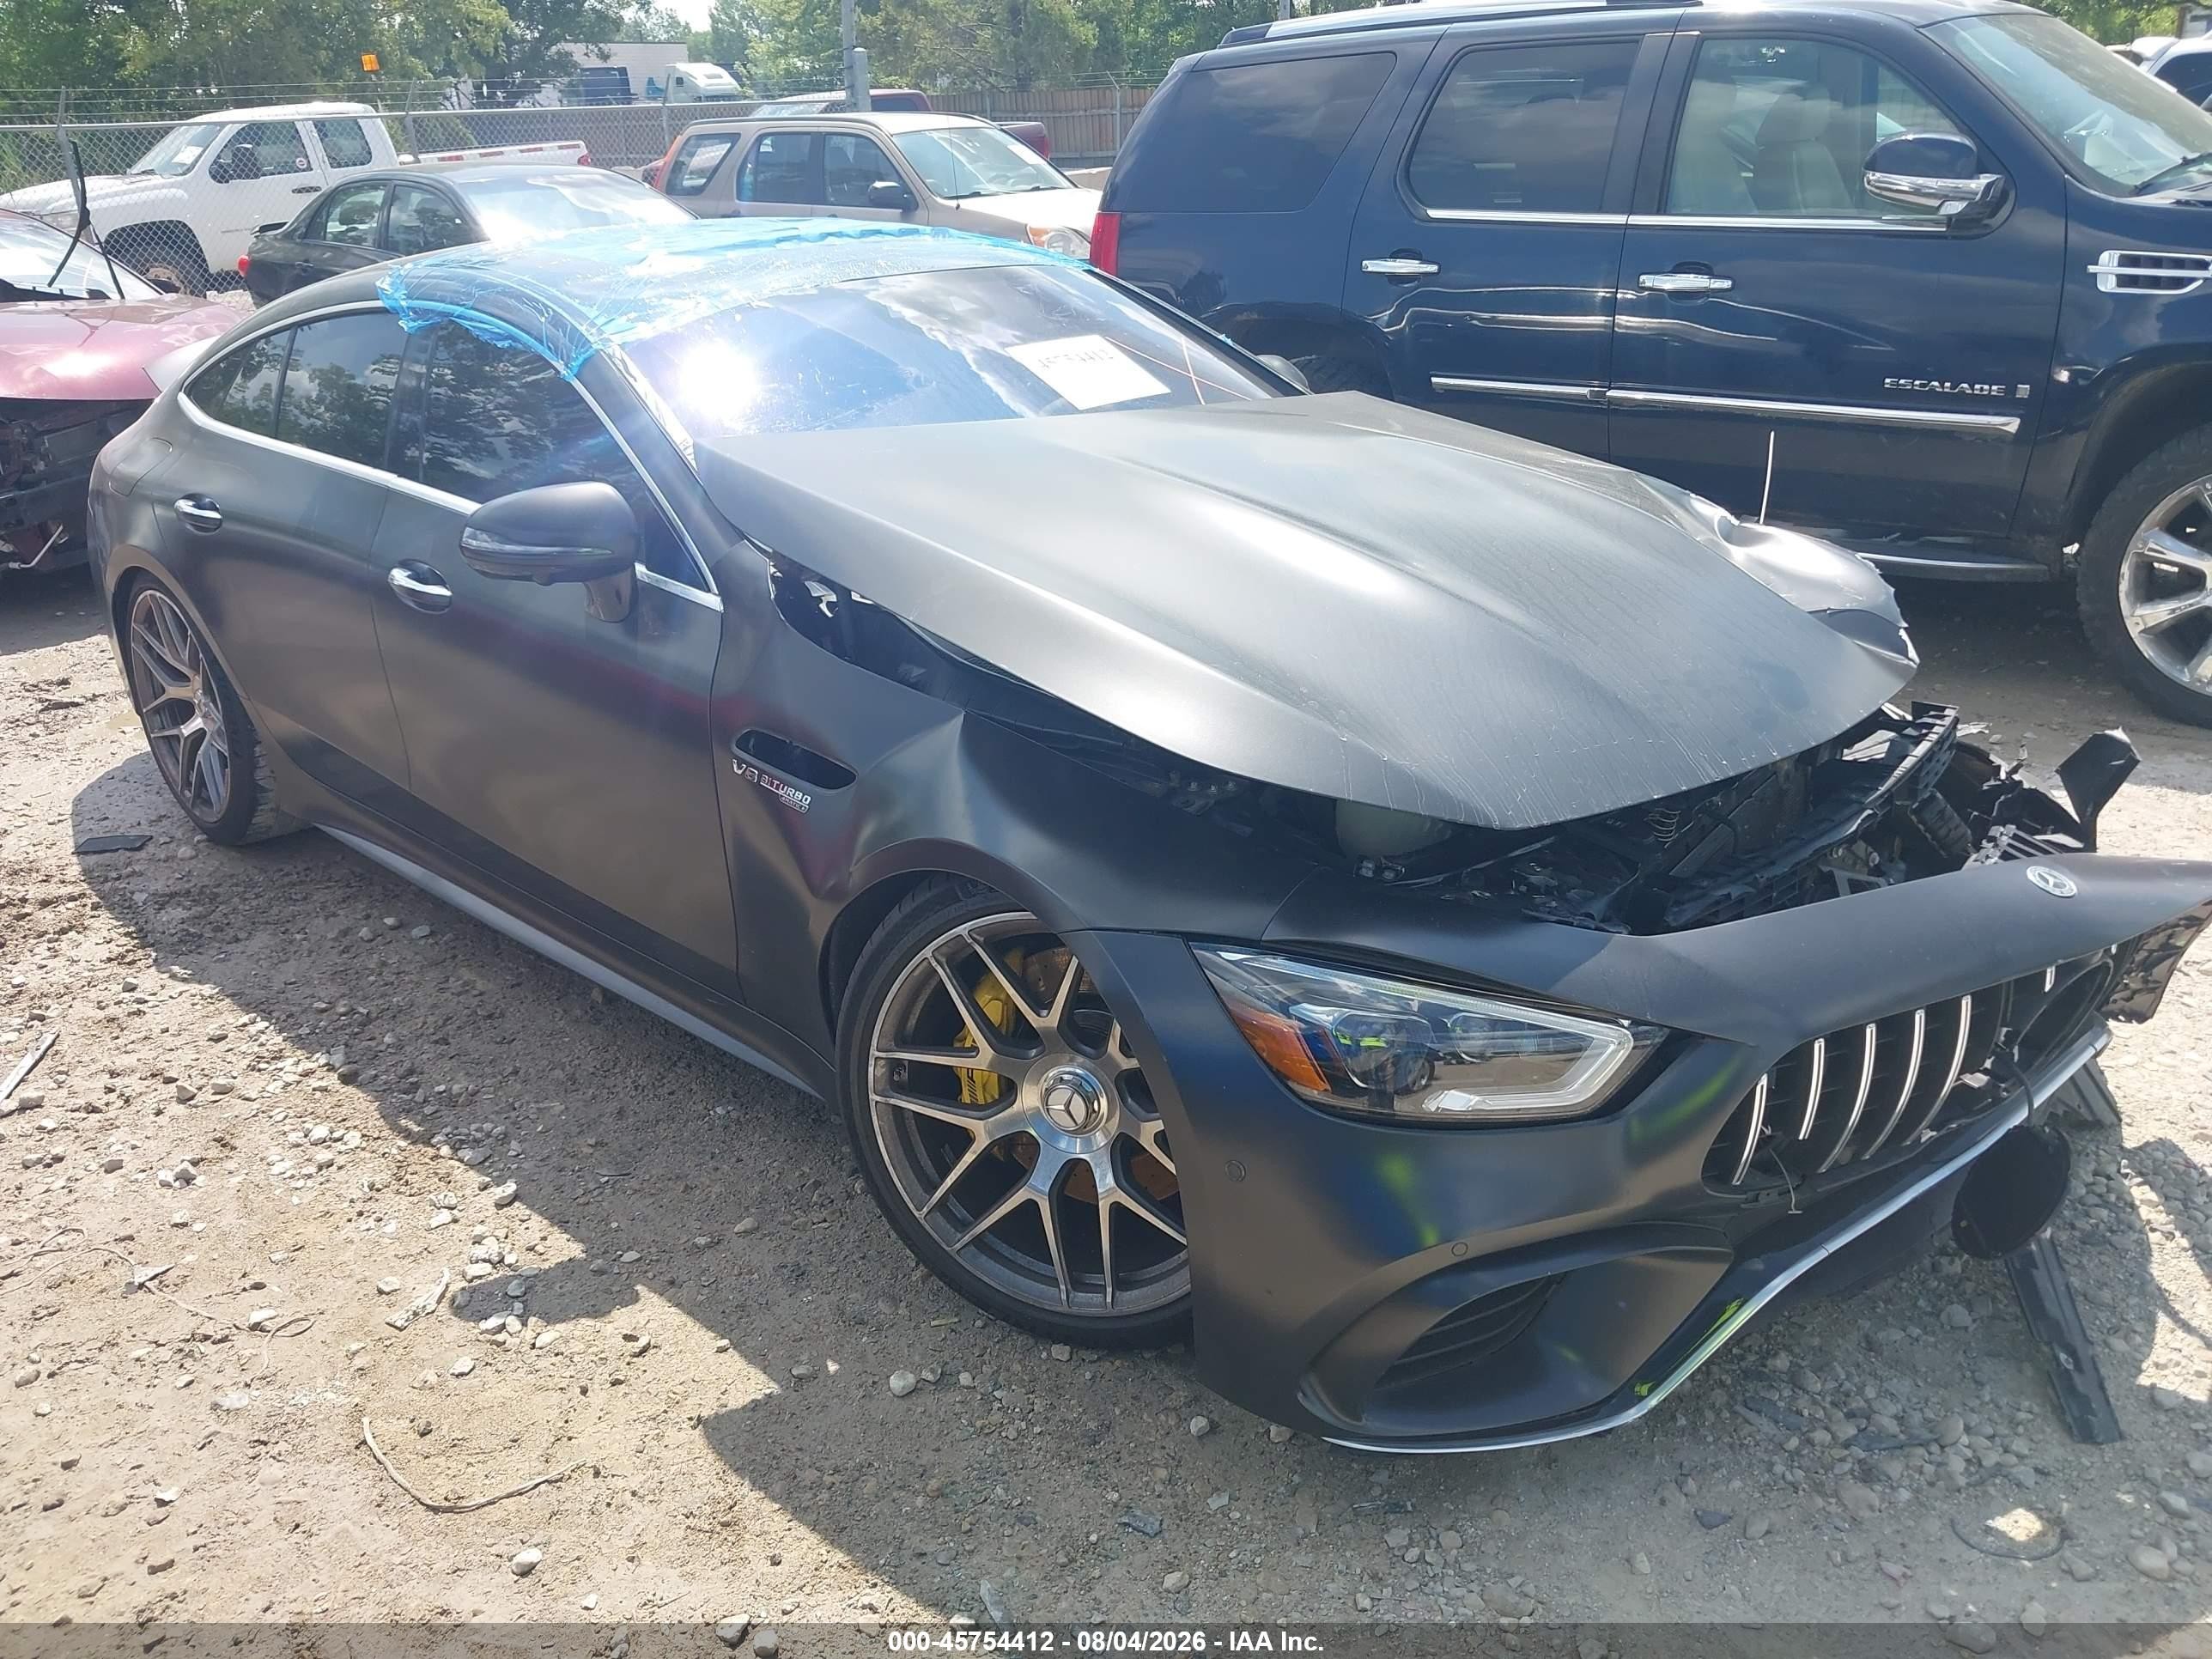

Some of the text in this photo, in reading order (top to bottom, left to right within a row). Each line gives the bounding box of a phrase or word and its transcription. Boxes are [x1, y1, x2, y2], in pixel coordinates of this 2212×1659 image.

[1883, 378, 2007, 397] ESCALADE
[732, 758, 811, 805] V8 BITURBO
